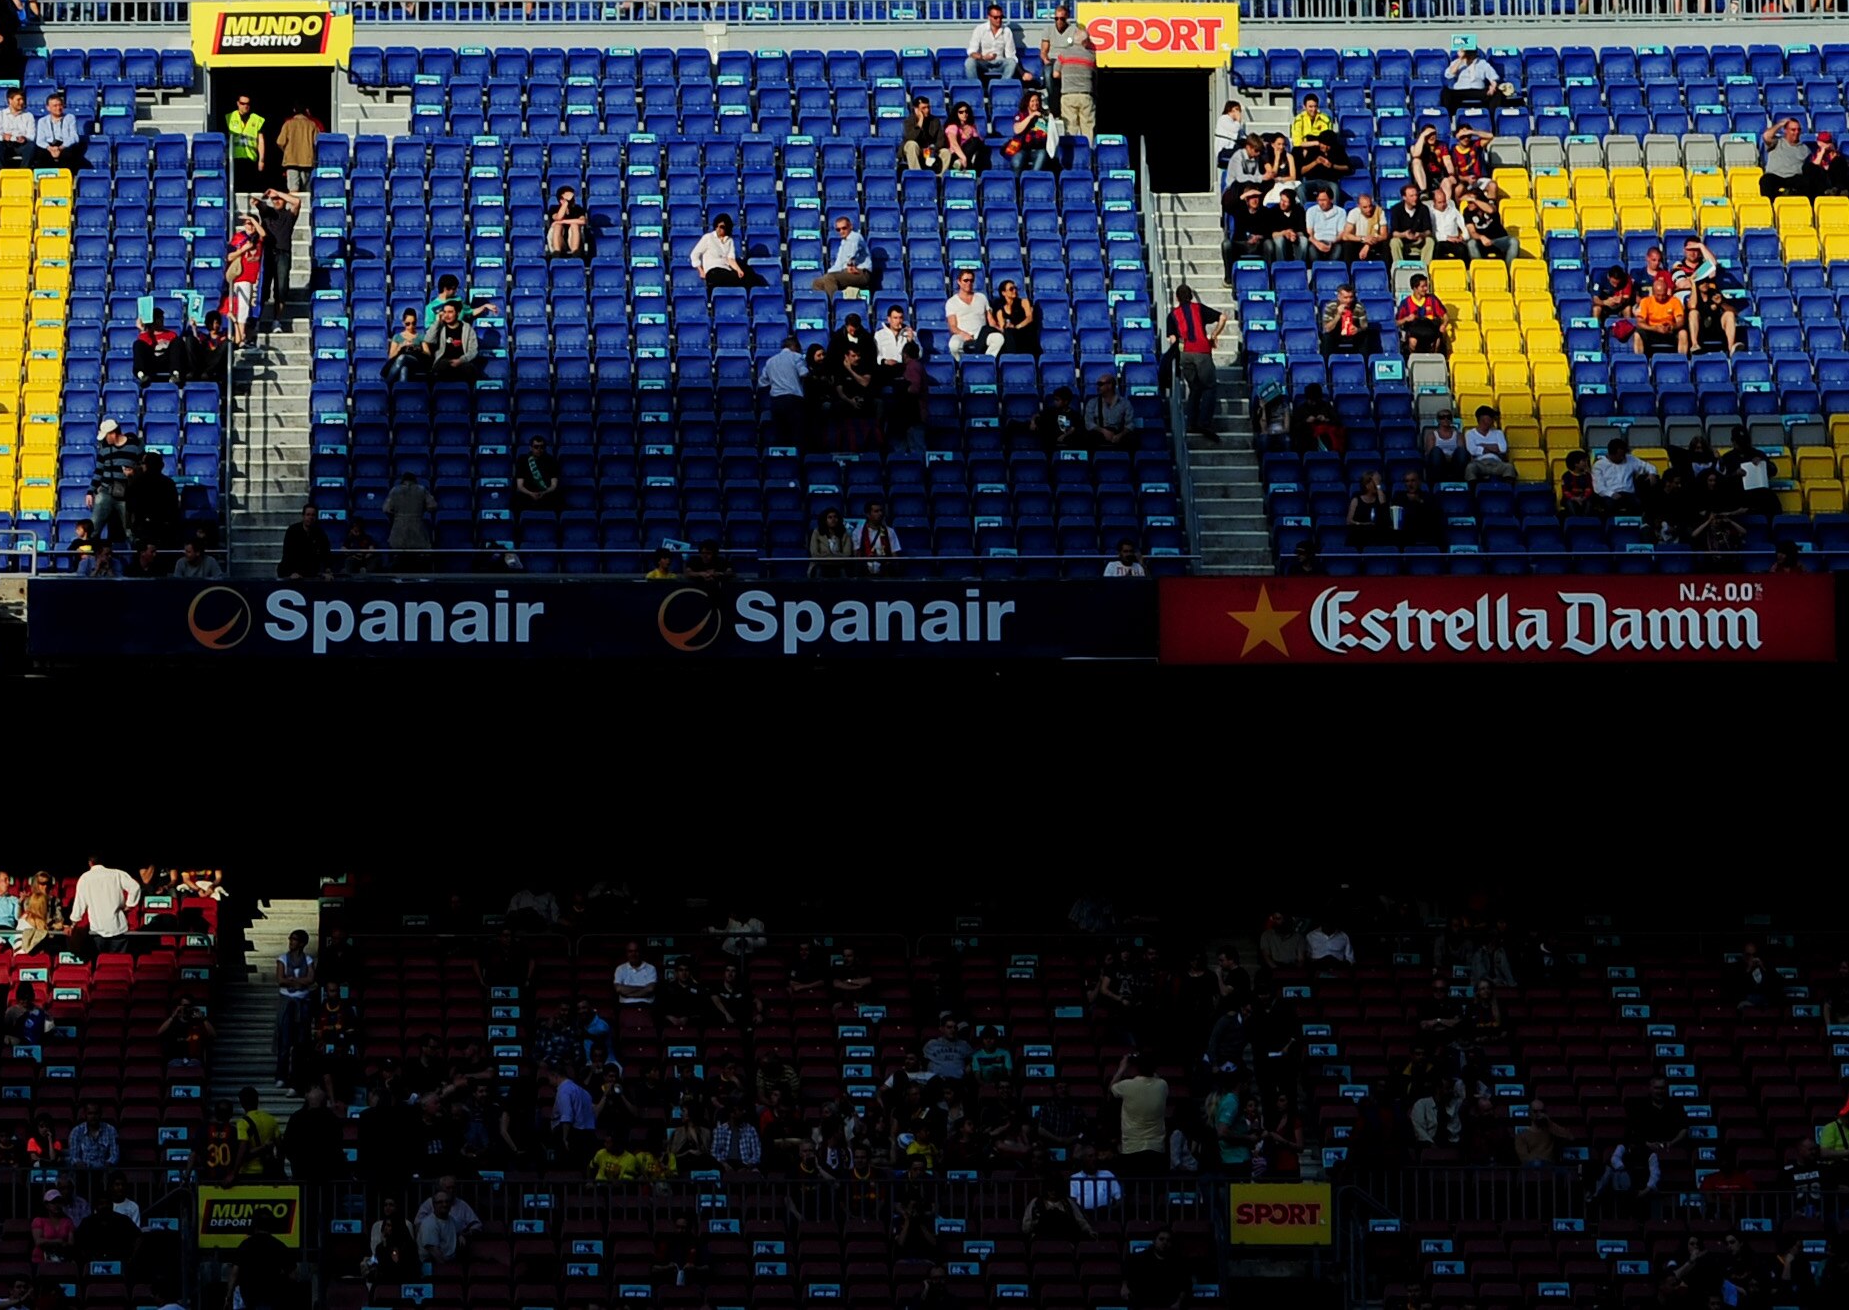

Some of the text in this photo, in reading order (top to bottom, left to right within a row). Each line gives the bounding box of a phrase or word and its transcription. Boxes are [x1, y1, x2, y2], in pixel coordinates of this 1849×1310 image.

[221, 34, 302, 47] DEPORTIVO
[223, 15, 324, 36] MUNDO
[1086, 17, 1223, 52] SPORT
[264, 589, 545, 654] Spanair
[735, 589, 1015, 654] Spanair
[1309, 585, 1764, 656] Estrella Damm
[206, 1142, 231, 1168] 30
[1237, 1202, 1321, 1225] SPORT
